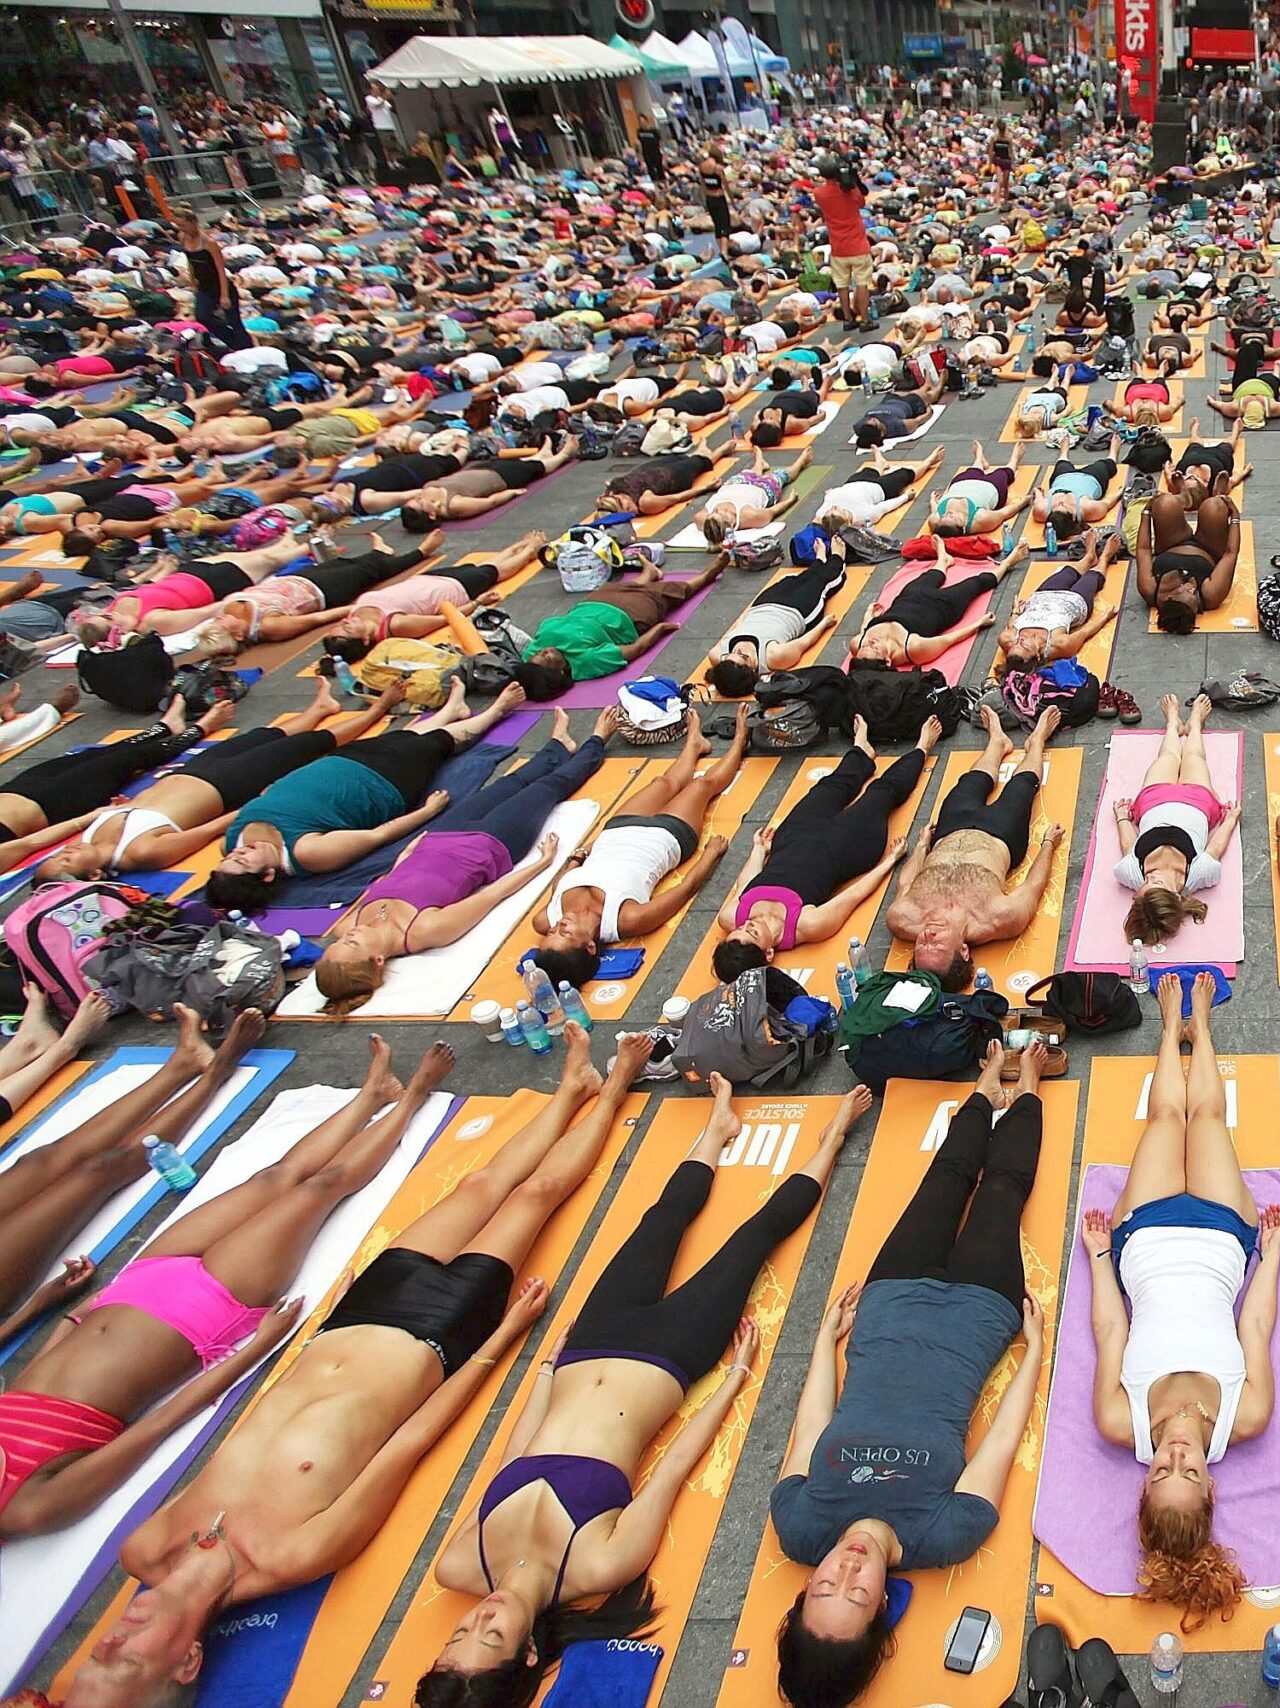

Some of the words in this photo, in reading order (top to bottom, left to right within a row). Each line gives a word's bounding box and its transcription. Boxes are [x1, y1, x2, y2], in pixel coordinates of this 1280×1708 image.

[1125, 0, 1150, 51] kts
[743, 1109, 808, 1120] SOLSTICE
[840, 1447, 901, 1462] OPEN
[904, 1448, 931, 1467] US
